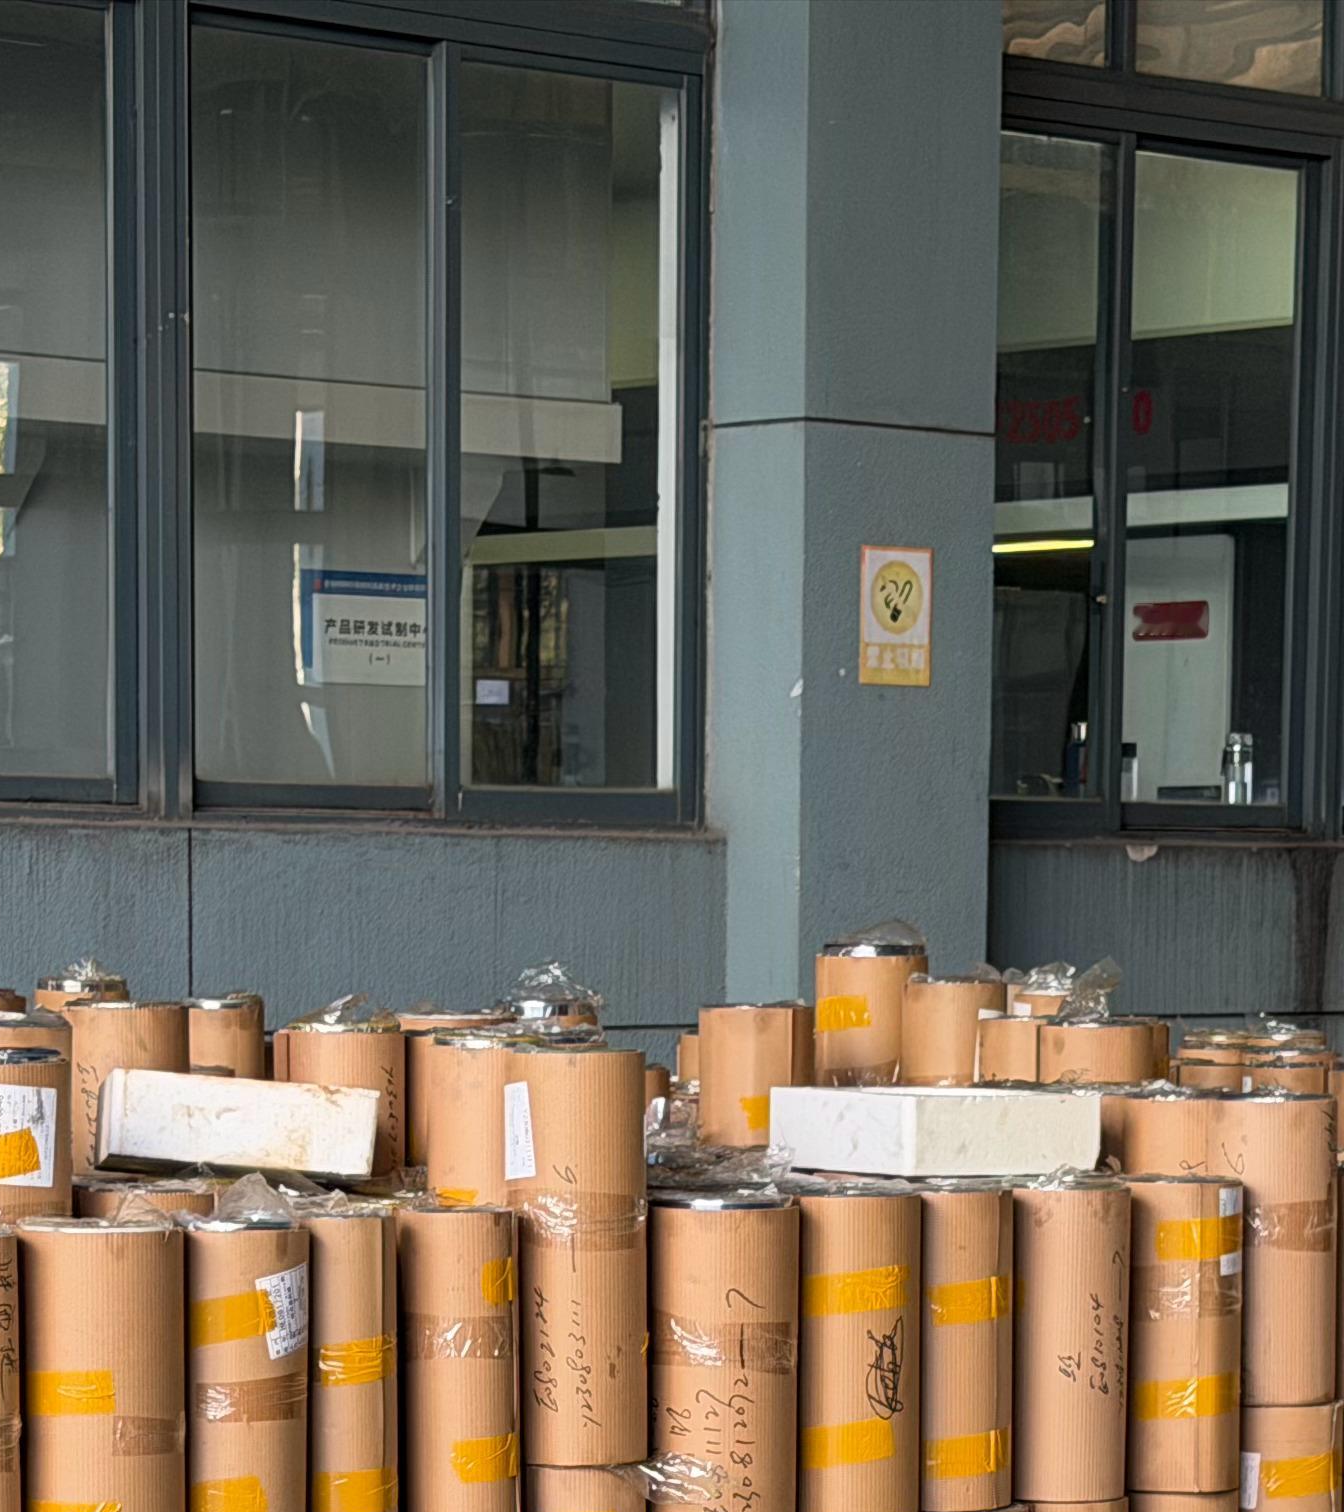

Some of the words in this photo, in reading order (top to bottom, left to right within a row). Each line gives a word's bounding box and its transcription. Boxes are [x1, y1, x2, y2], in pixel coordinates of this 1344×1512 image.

[324, 618, 427, 637] 产品研发试制中
